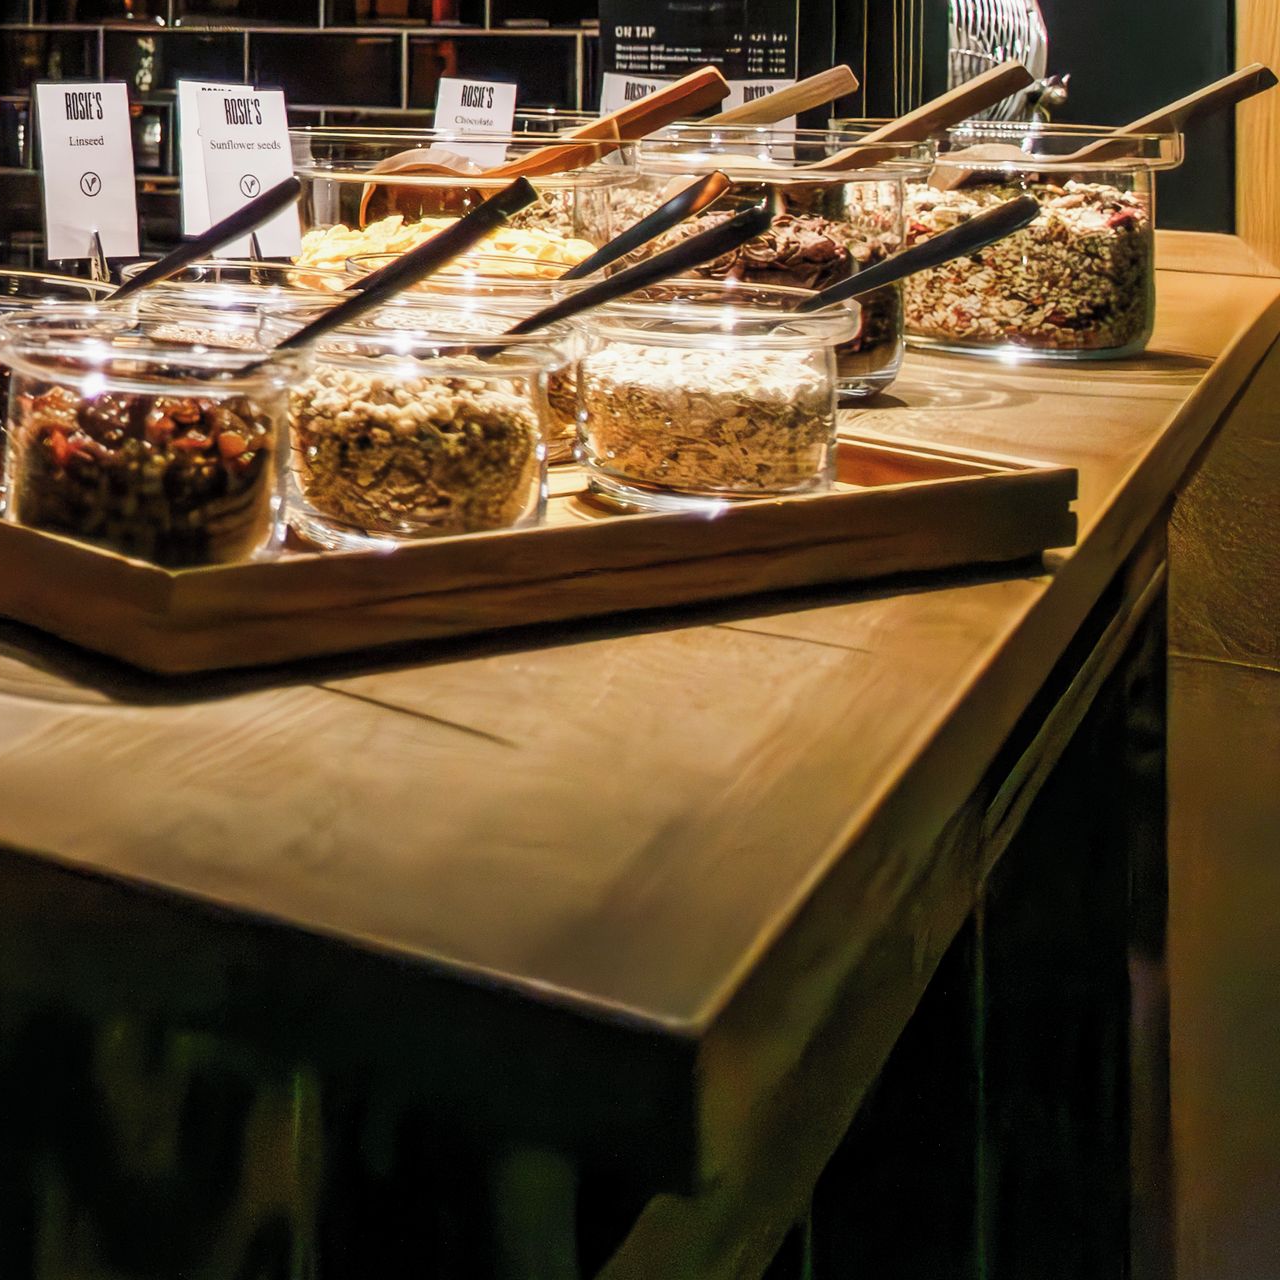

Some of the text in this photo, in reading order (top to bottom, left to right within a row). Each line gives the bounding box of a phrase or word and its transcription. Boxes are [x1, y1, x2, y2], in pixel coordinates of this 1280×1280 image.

[615, 26, 656, 38] ON TAP
[65, 92, 103, 120] ROSIE'S
[461, 85, 494, 109] ROSIE'S
[224, 98, 262, 125] ROSIE'S
[69, 135, 105, 147] Linseed
[210, 140, 281, 150] Sunflower seeds
